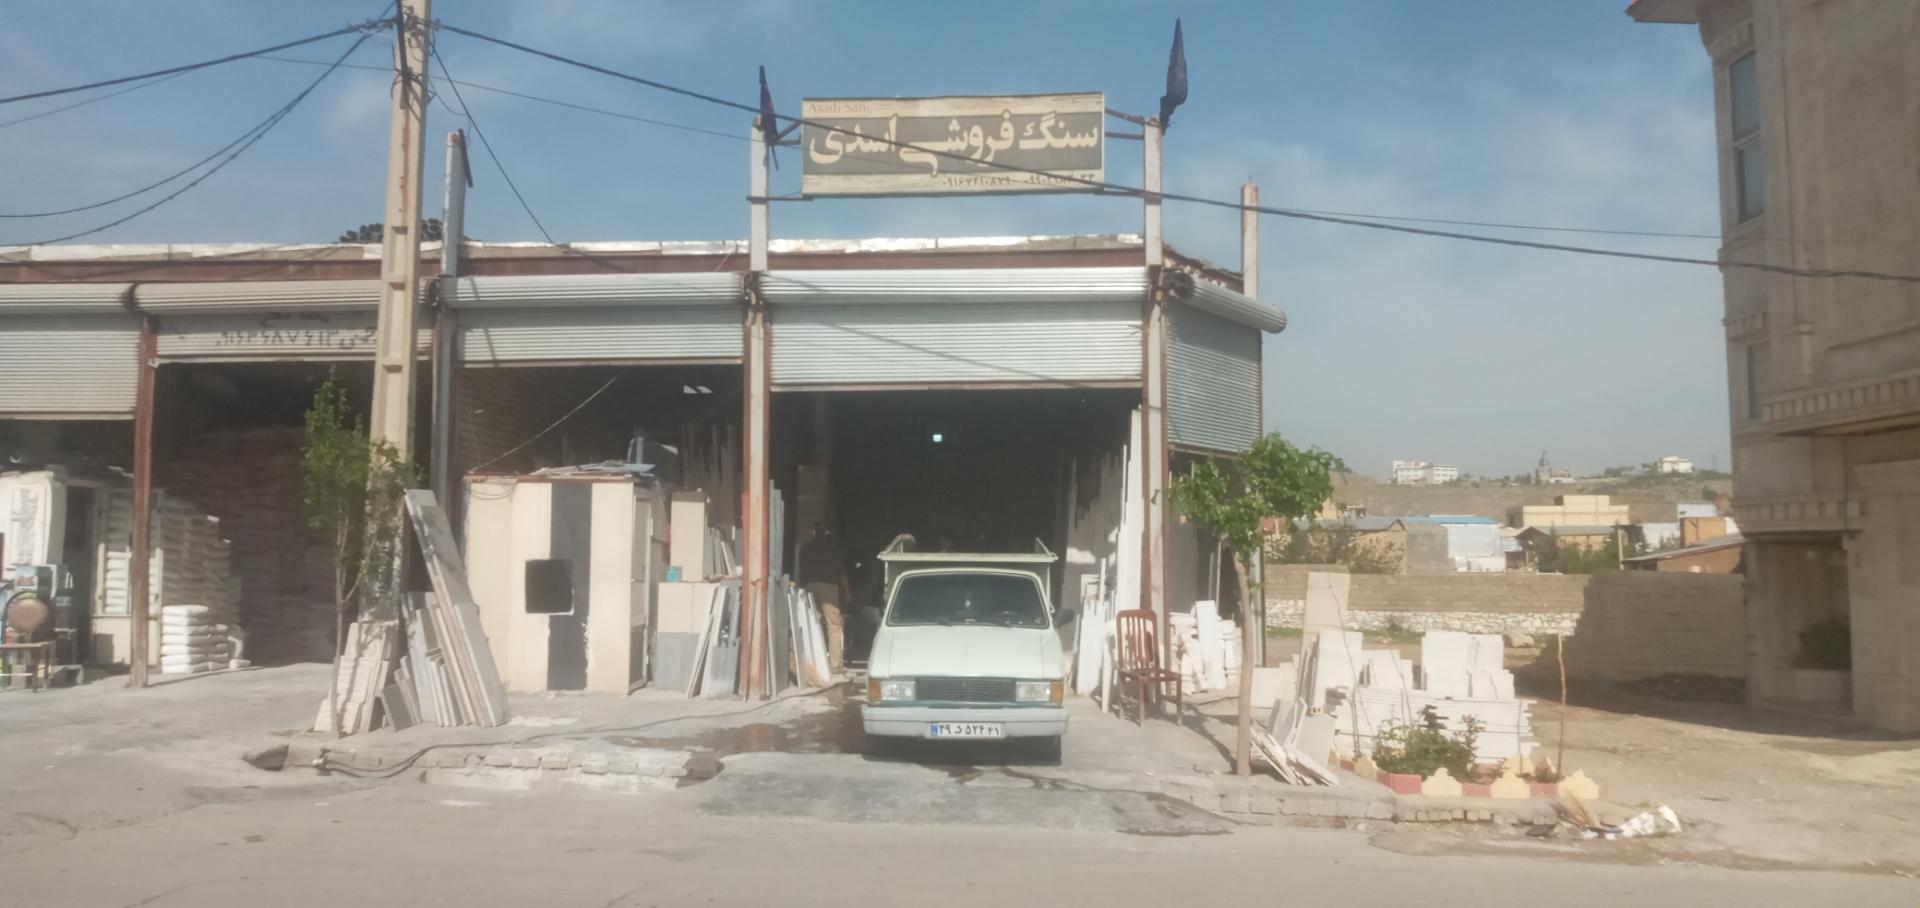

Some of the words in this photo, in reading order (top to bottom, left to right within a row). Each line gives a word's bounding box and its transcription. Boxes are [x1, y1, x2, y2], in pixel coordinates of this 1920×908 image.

[808, 102, 841, 113] Asadi
[844, 102, 873, 115] Sang
[1019, 112, 1099, 150] سنگ
[809, 113, 898, 165] اسدی
[898, 109, 1015, 178] فروشی
